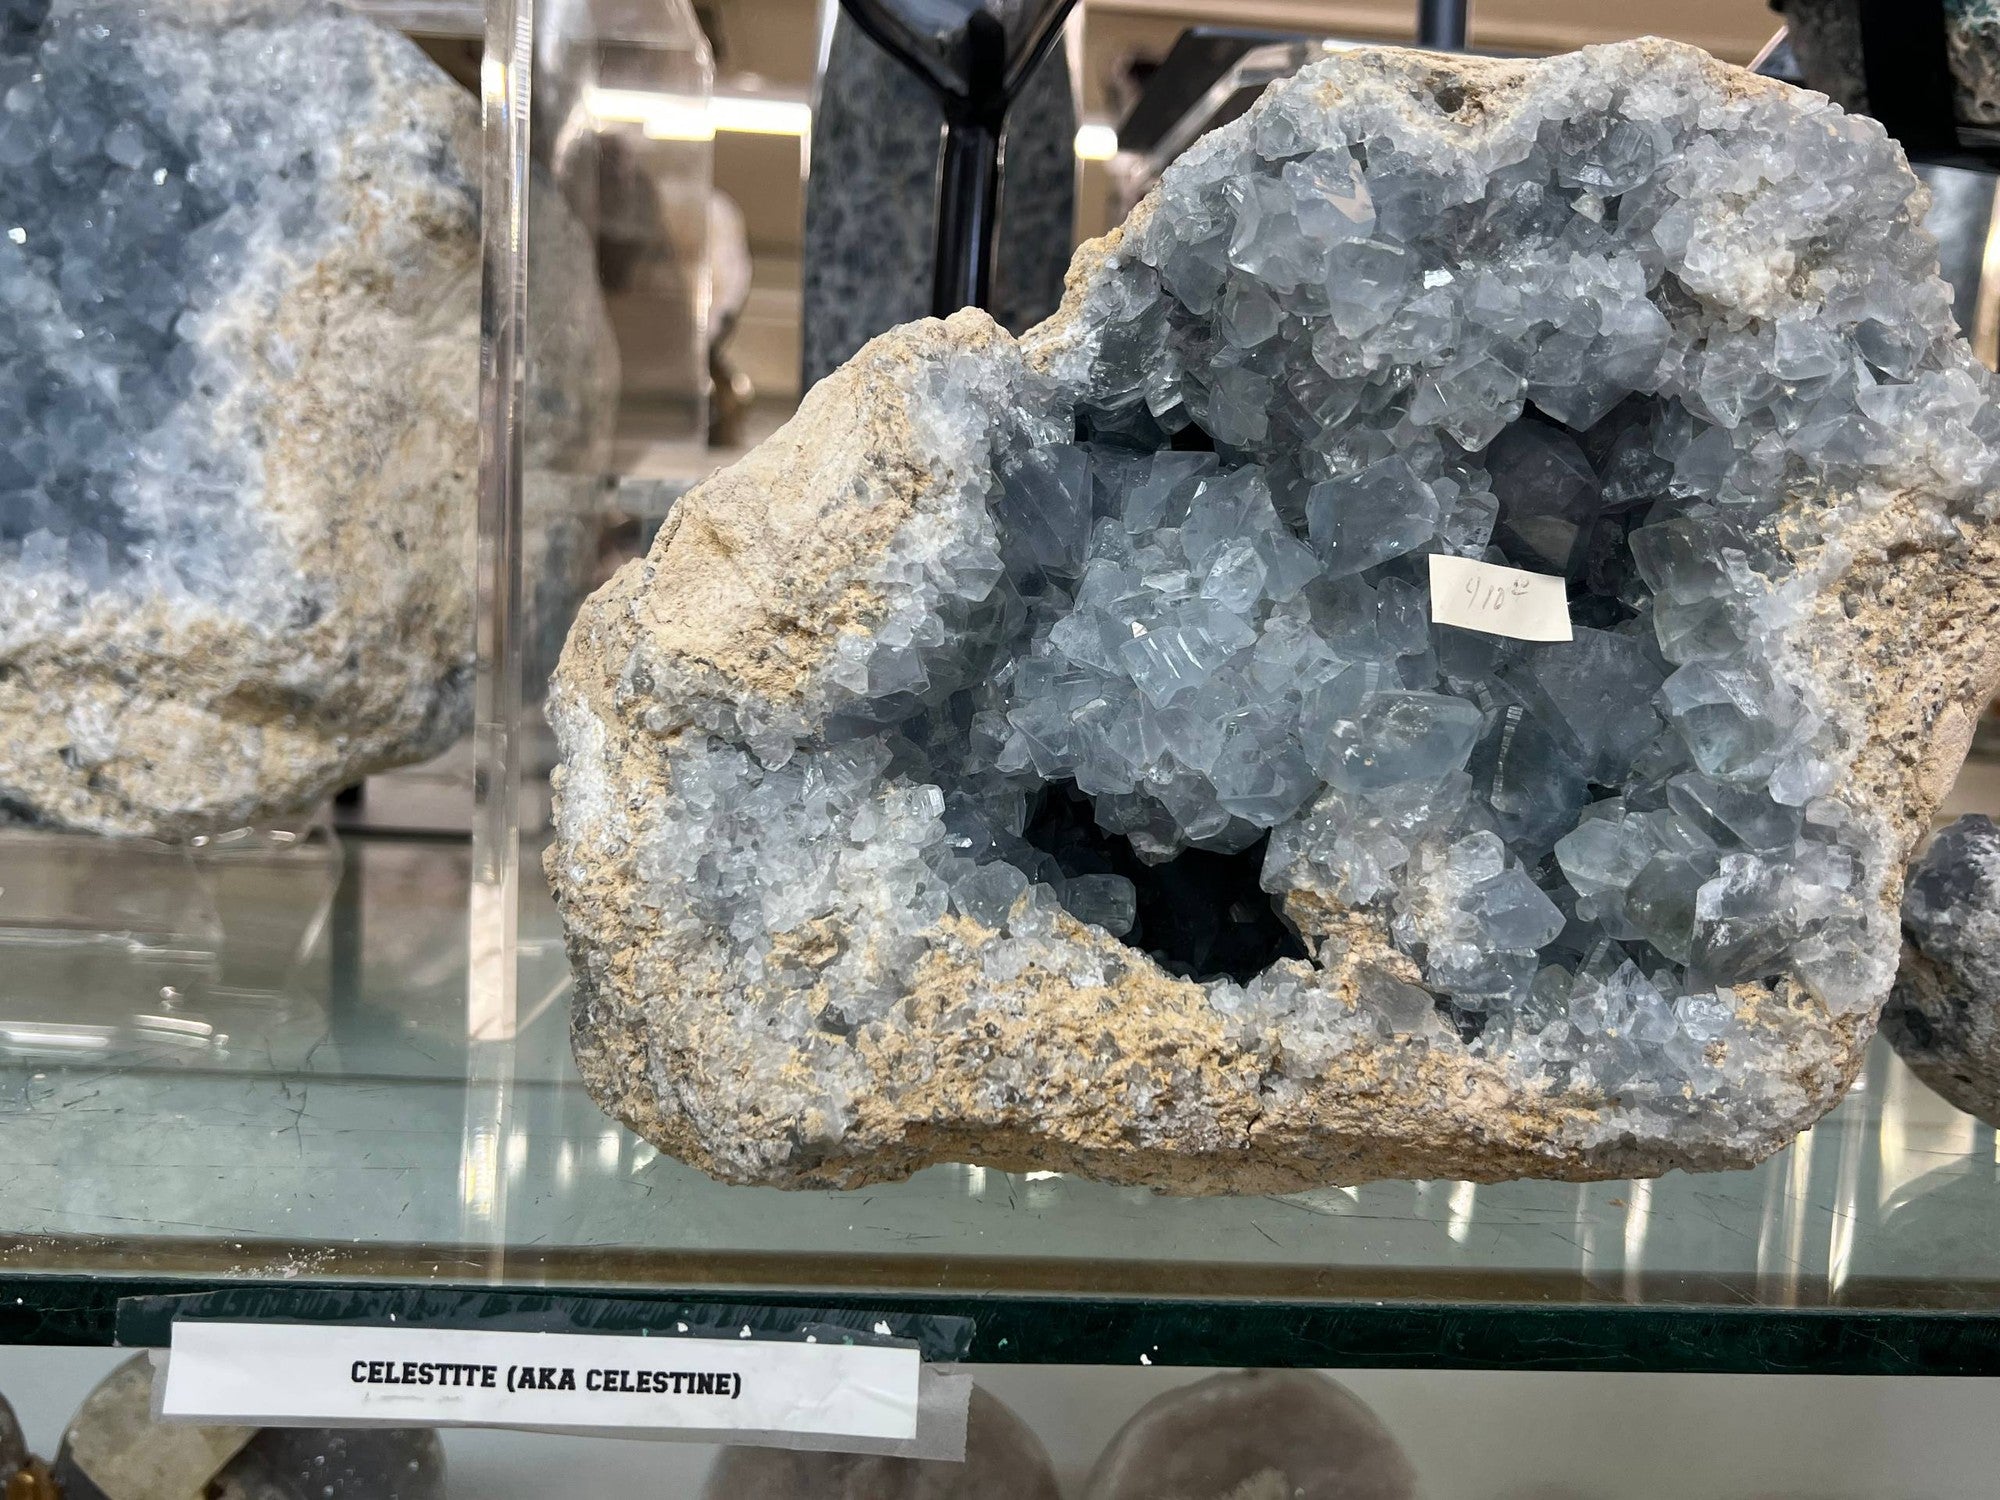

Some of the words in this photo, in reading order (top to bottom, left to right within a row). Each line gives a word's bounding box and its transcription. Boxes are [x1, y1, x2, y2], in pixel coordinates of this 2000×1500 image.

[351, 1360, 498, 1388] CELESTITE
[506, 1365, 576, 1394] (AKA
[585, 1369, 742, 1400] CELESTINE)
